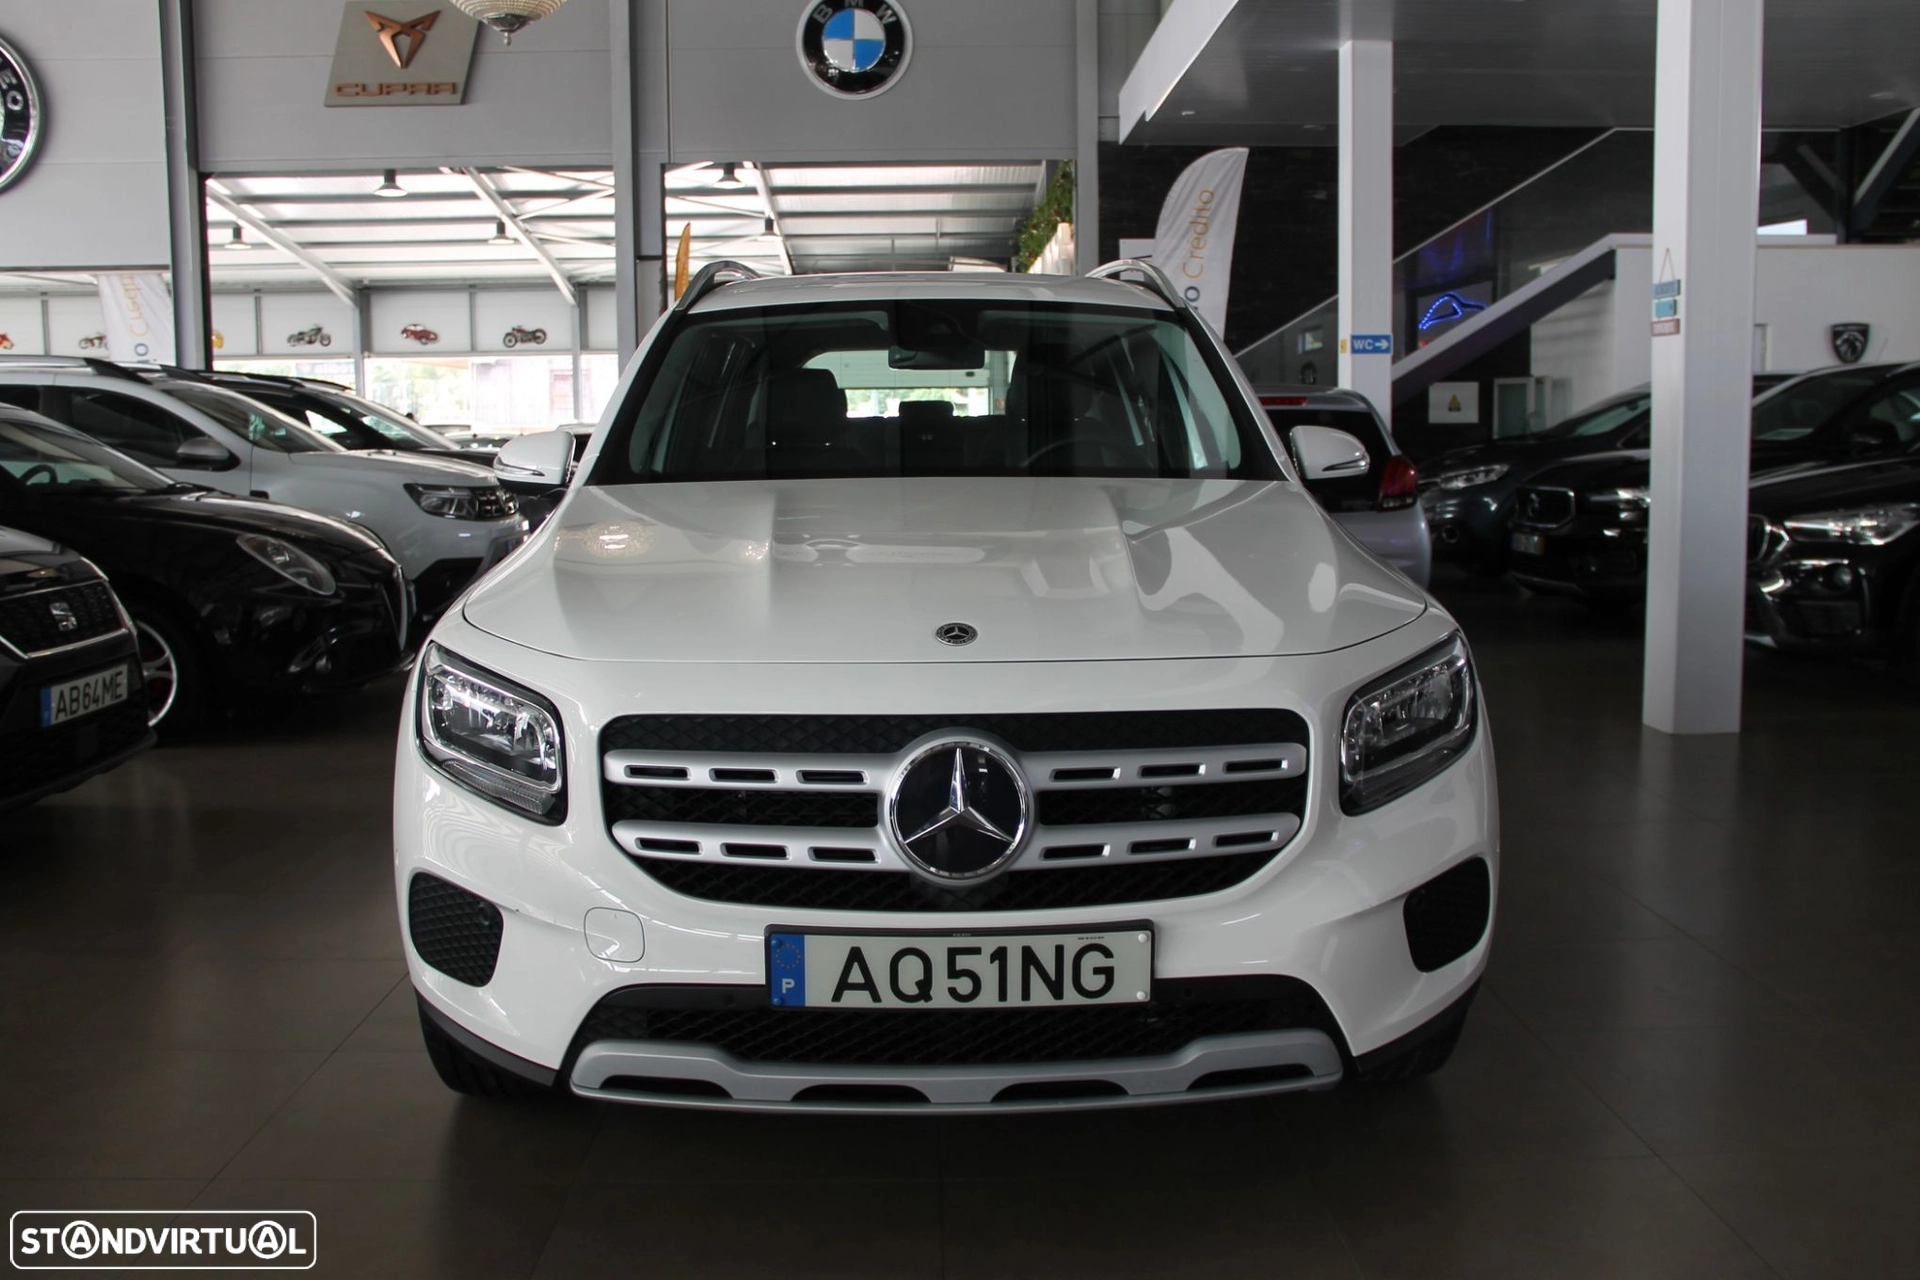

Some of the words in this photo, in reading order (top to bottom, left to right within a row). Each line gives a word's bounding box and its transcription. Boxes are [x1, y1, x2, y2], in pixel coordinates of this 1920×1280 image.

[333, 81, 458, 97] CUPRA
[1353, 338, 1374, 350] WC
[54, 670, 124, 721] AB64ME
[782, 978, 795, 994] P
